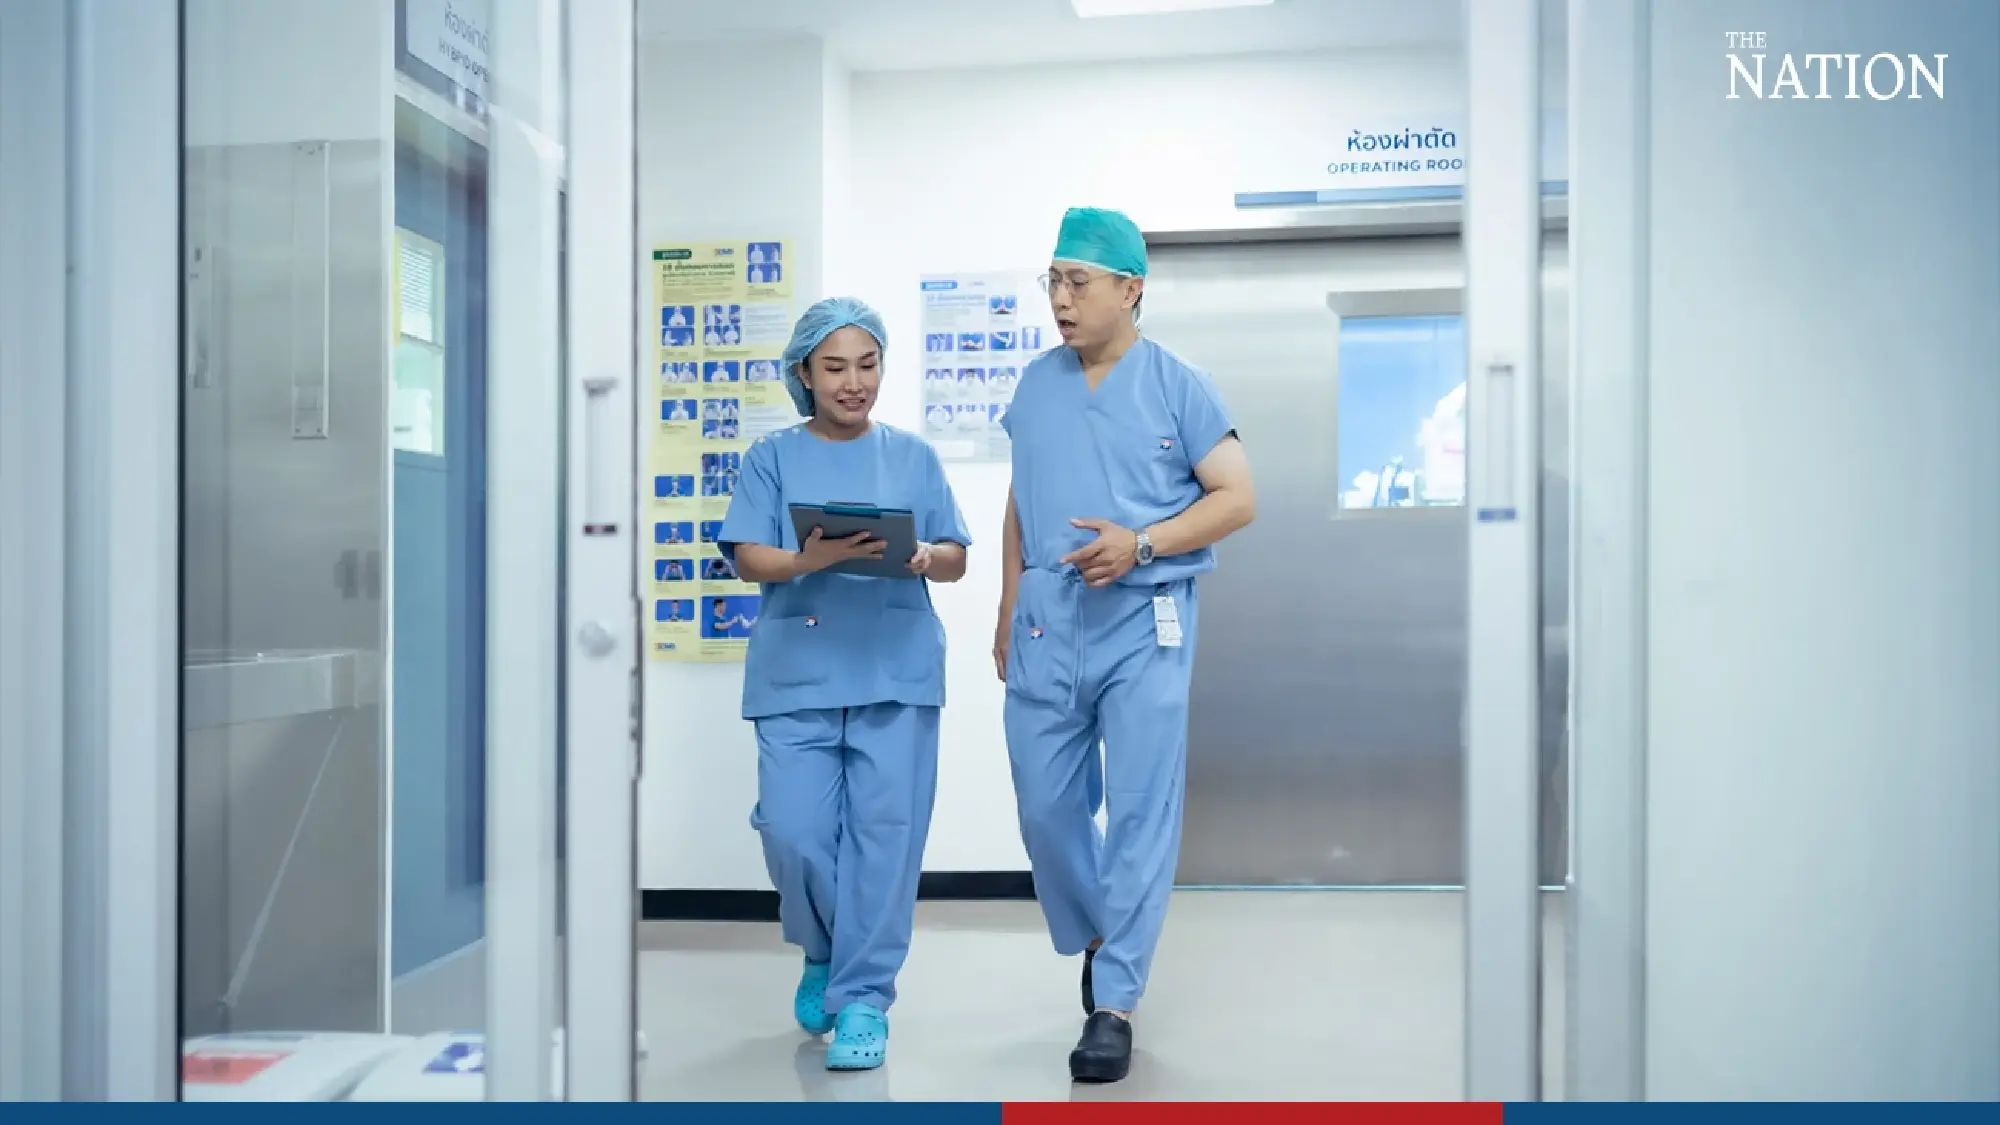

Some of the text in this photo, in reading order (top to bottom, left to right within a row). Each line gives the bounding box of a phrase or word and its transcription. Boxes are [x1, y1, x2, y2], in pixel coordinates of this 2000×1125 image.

[1347, 127, 1456, 152] ห้องผ่าตัด
[1327, 158, 1467, 175] OPERATING ROO
